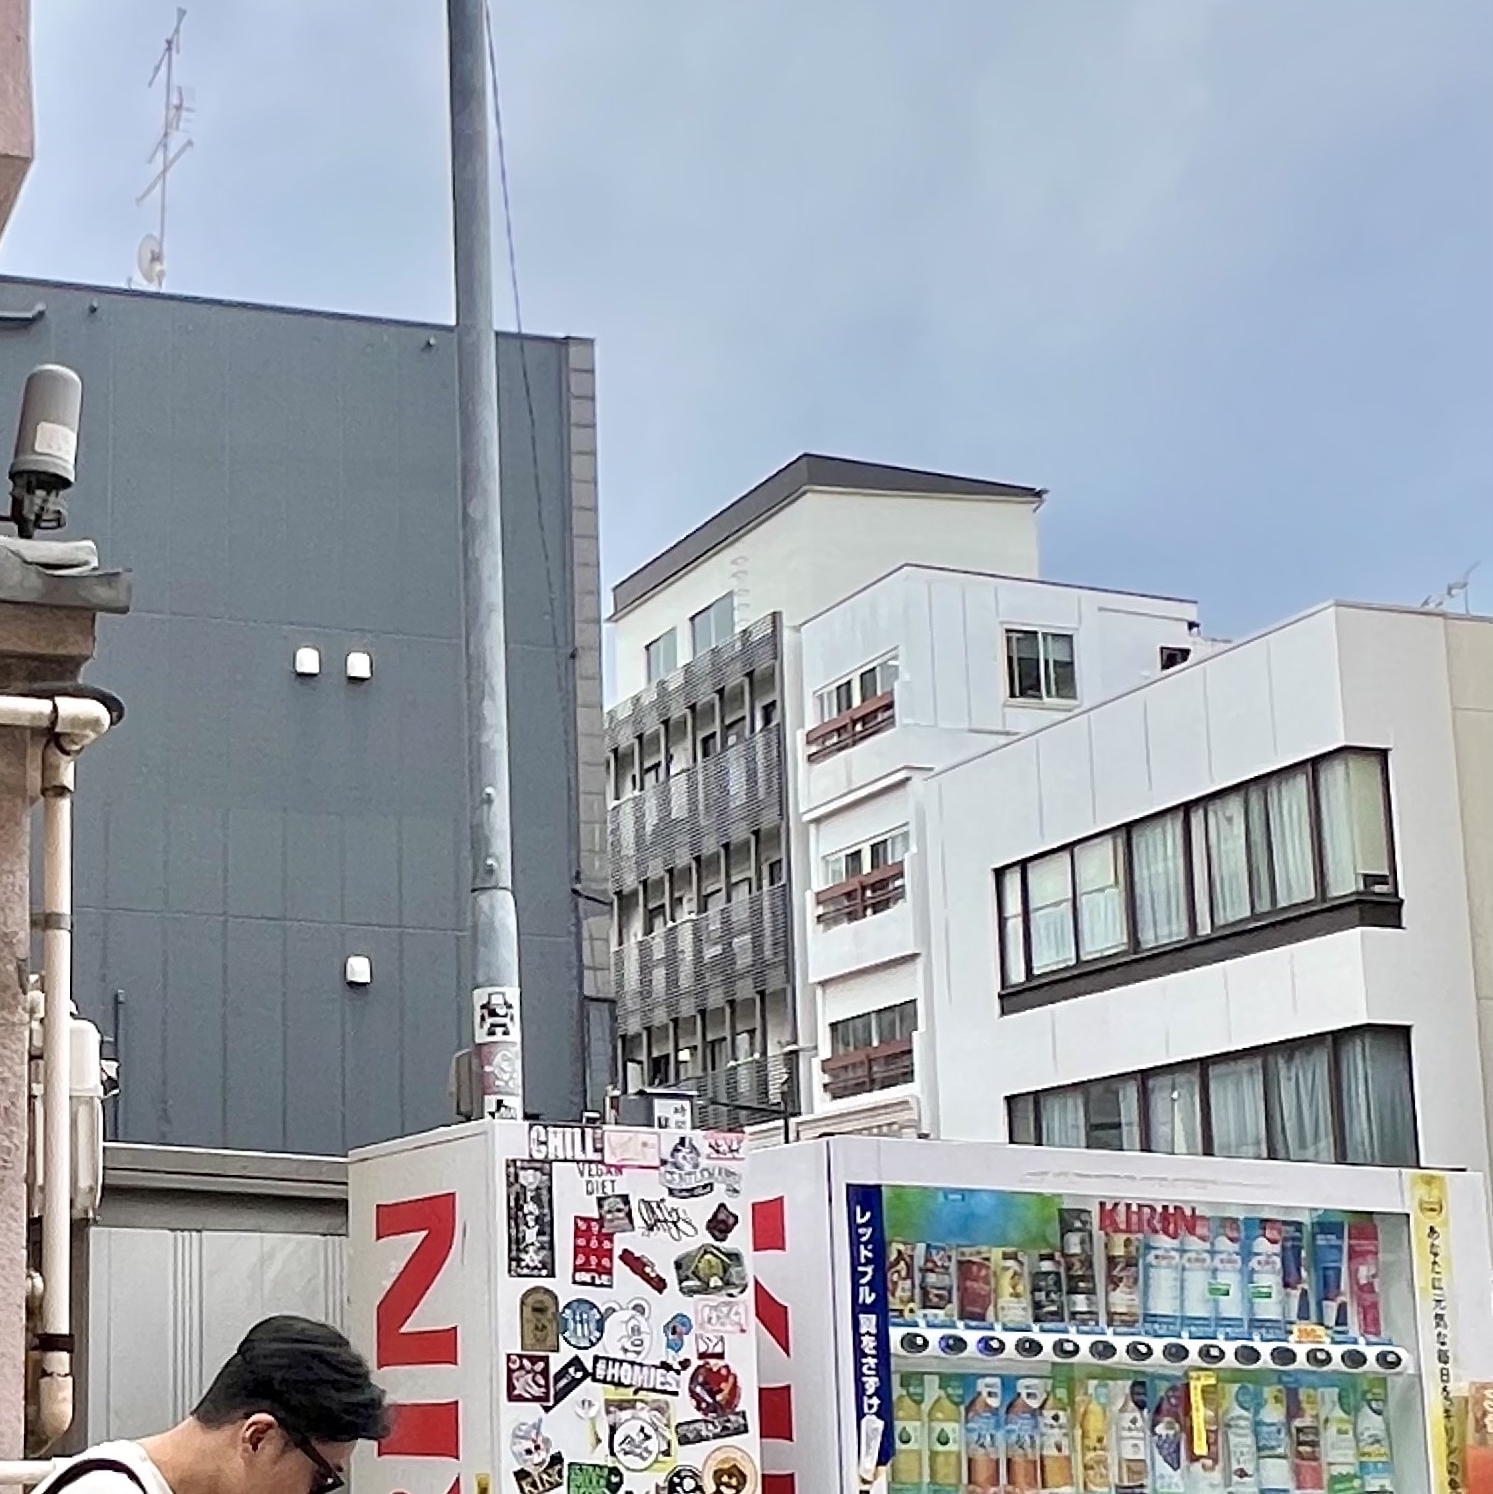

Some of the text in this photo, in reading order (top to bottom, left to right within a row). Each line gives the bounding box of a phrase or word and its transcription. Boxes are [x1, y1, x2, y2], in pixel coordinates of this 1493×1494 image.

[530, 1125, 597, 1159] CHILL
[585, 1179, 617, 1196] DIET
[1099, 1201, 1196, 1240] KIRIN
[855, 1205, 877, 1306] レッドブル
[595, 1356, 682, 1391] #HOMIES
